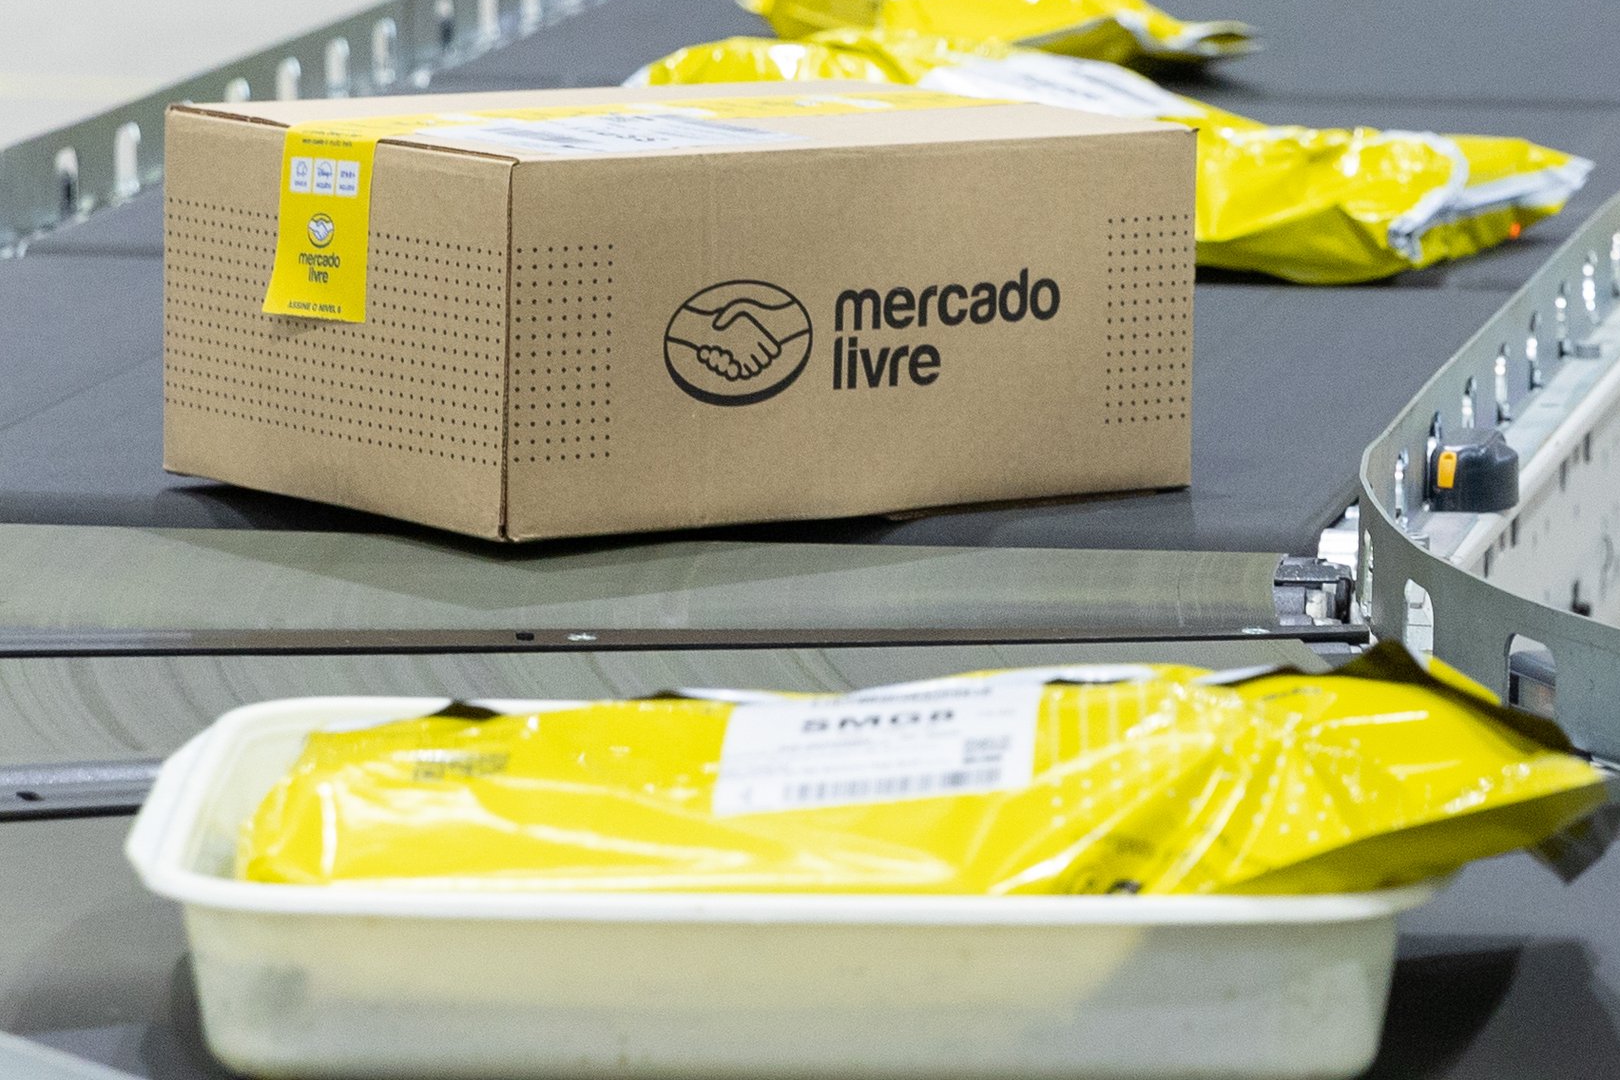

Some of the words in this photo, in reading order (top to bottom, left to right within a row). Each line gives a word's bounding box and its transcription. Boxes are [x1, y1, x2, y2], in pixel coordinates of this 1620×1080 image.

[298, 252, 341, 268] mercado
[308, 267, 329, 283] livre
[834, 267, 1061, 332] mercado
[832, 336, 942, 391] livre
